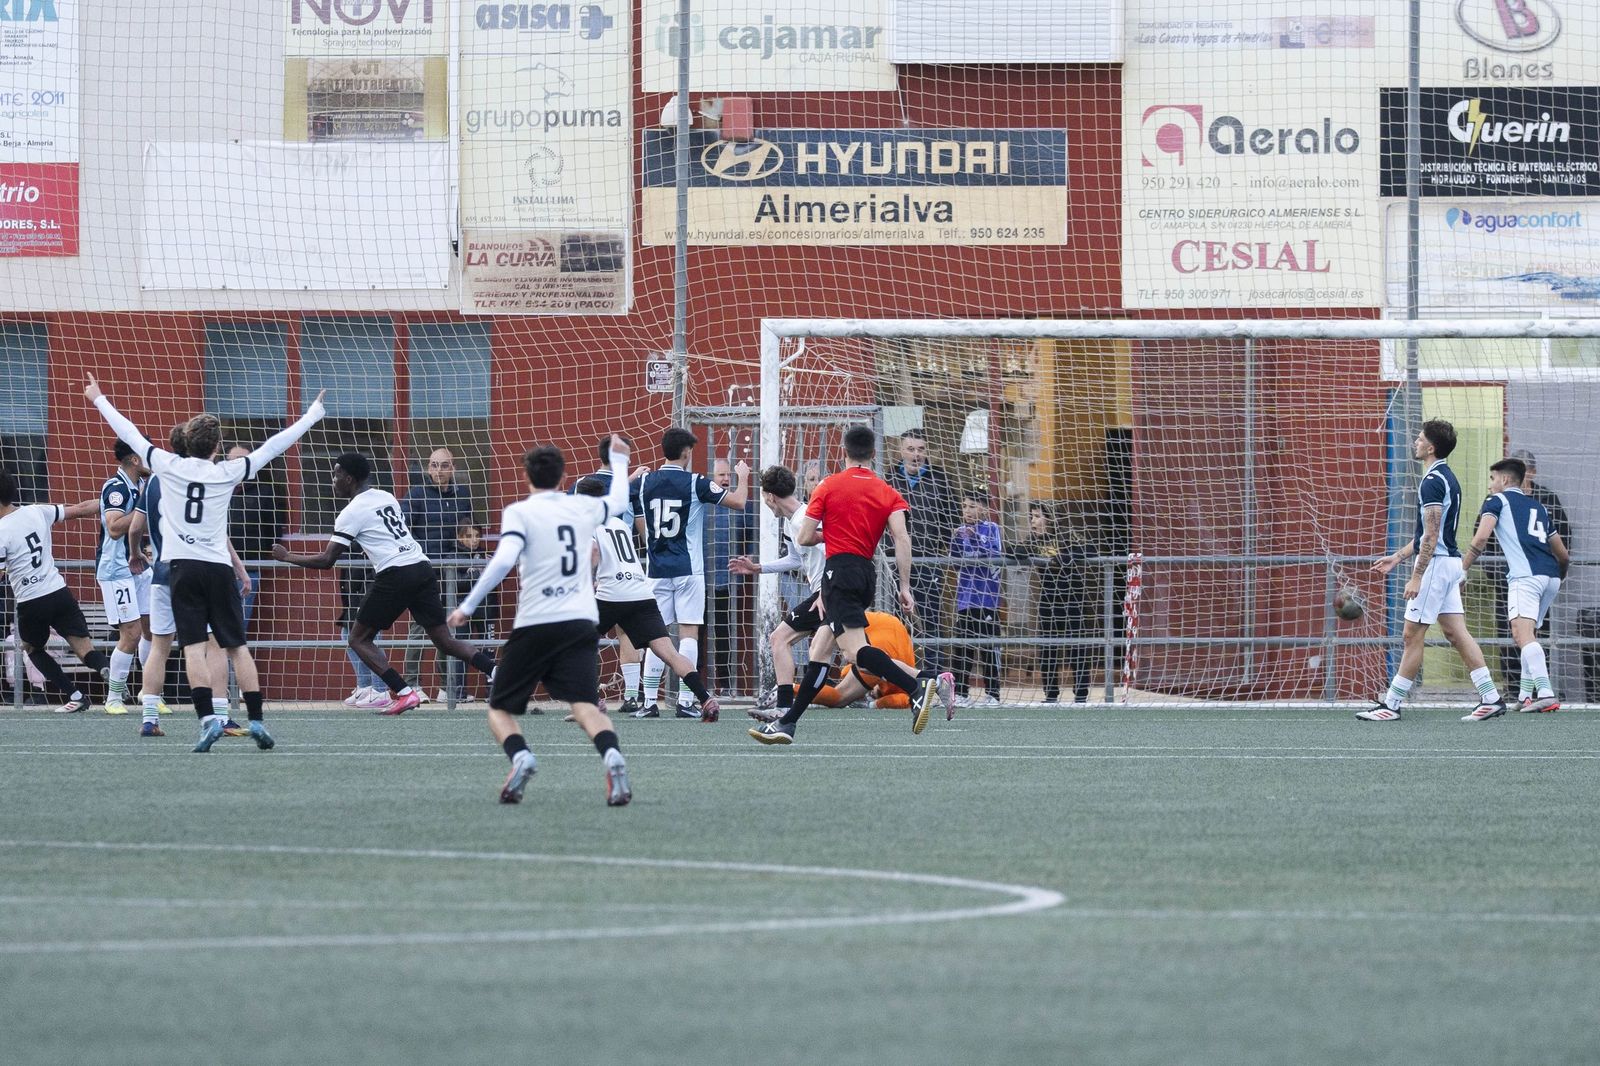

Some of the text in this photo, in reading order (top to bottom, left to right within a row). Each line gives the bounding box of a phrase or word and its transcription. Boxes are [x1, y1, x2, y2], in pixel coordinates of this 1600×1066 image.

[476, 4, 570, 30] asisa
[322, 39, 402, 48] Spraying technology
[719, 15, 882, 60] cajamar
[799, 52, 880, 63] CAJA RURAL
[1463, 57, 1554, 80] Blanes
[31, 91, 64, 105] 2011
[1447, 98, 1571, 144] Guerin
[797, 141, 1009, 175] HYUNDAI
[1507, 162, 1517, 171] DE
[1518, 162, 1555, 172] MATERIAL
[1142, 177, 1165, 189] 950
[1169, 177, 1191, 189] 291
[1196, 177, 1221, 189] 420
[1250, 176, 1360, 189] info@aeralo.com
[1542, 174, 1587, 184] SANITARIOS
[755, 193, 953, 223] Almerialva
[1138, 209, 1186, 219] CENTRO
[1268, 208, 1341, 218] ALMERIENSE
[40, 219, 61, 229] S.L.
[1299, 221, 1312, 229] DE
[1475, 211, 1582, 233] aguaconfort
[970, 228, 992, 239] 950
[996, 228, 1019, 239] 624
[1023, 228, 1045, 239] 235
[466, 252, 557, 267] LA CURVA
[1171, 239, 1331, 274] CESIAL
[575, 300, 614, 310] (PACO)
[1164, 289, 1185, 300] 950
[1188, 289, 1210, 300] 300
[1212, 289, 1231, 300] 971
[1248, 288, 1364, 302] josecarlos@cesial.es
[185, 482, 205, 524] 8
[376, 505, 407, 540] 19
[650, 498, 682, 539] 15
[1527, 508, 1547, 544] 4
[24, 532, 43, 569] 5
[558, 525, 578, 577] 3
[605, 528, 635, 564] 10
[115, 588, 132, 604] 21
